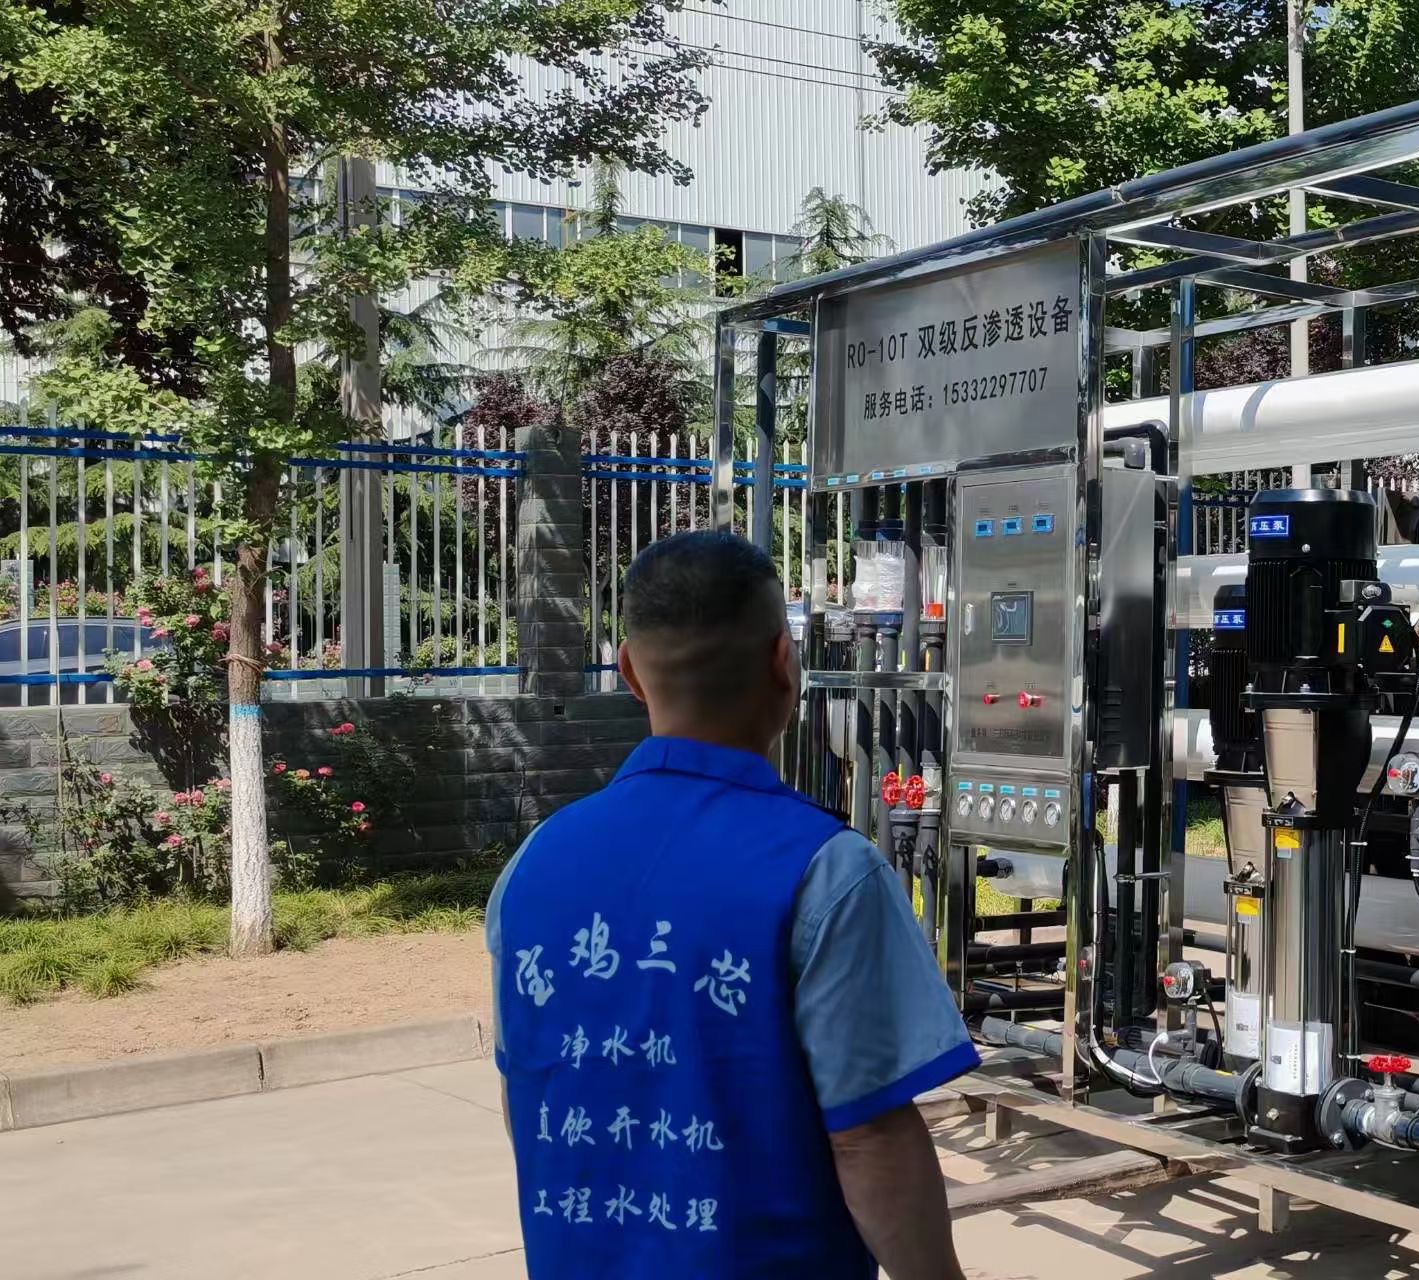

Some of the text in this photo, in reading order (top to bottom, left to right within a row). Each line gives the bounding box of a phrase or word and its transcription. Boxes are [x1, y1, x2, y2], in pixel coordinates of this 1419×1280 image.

[917, 295, 1073, 360] 双级反渗透设备
[560, 1024, 677, 1070] 净水机
[536, 1101, 725, 1153] 直饮开水机
[533, 1184, 719, 1232] 工程水处理
